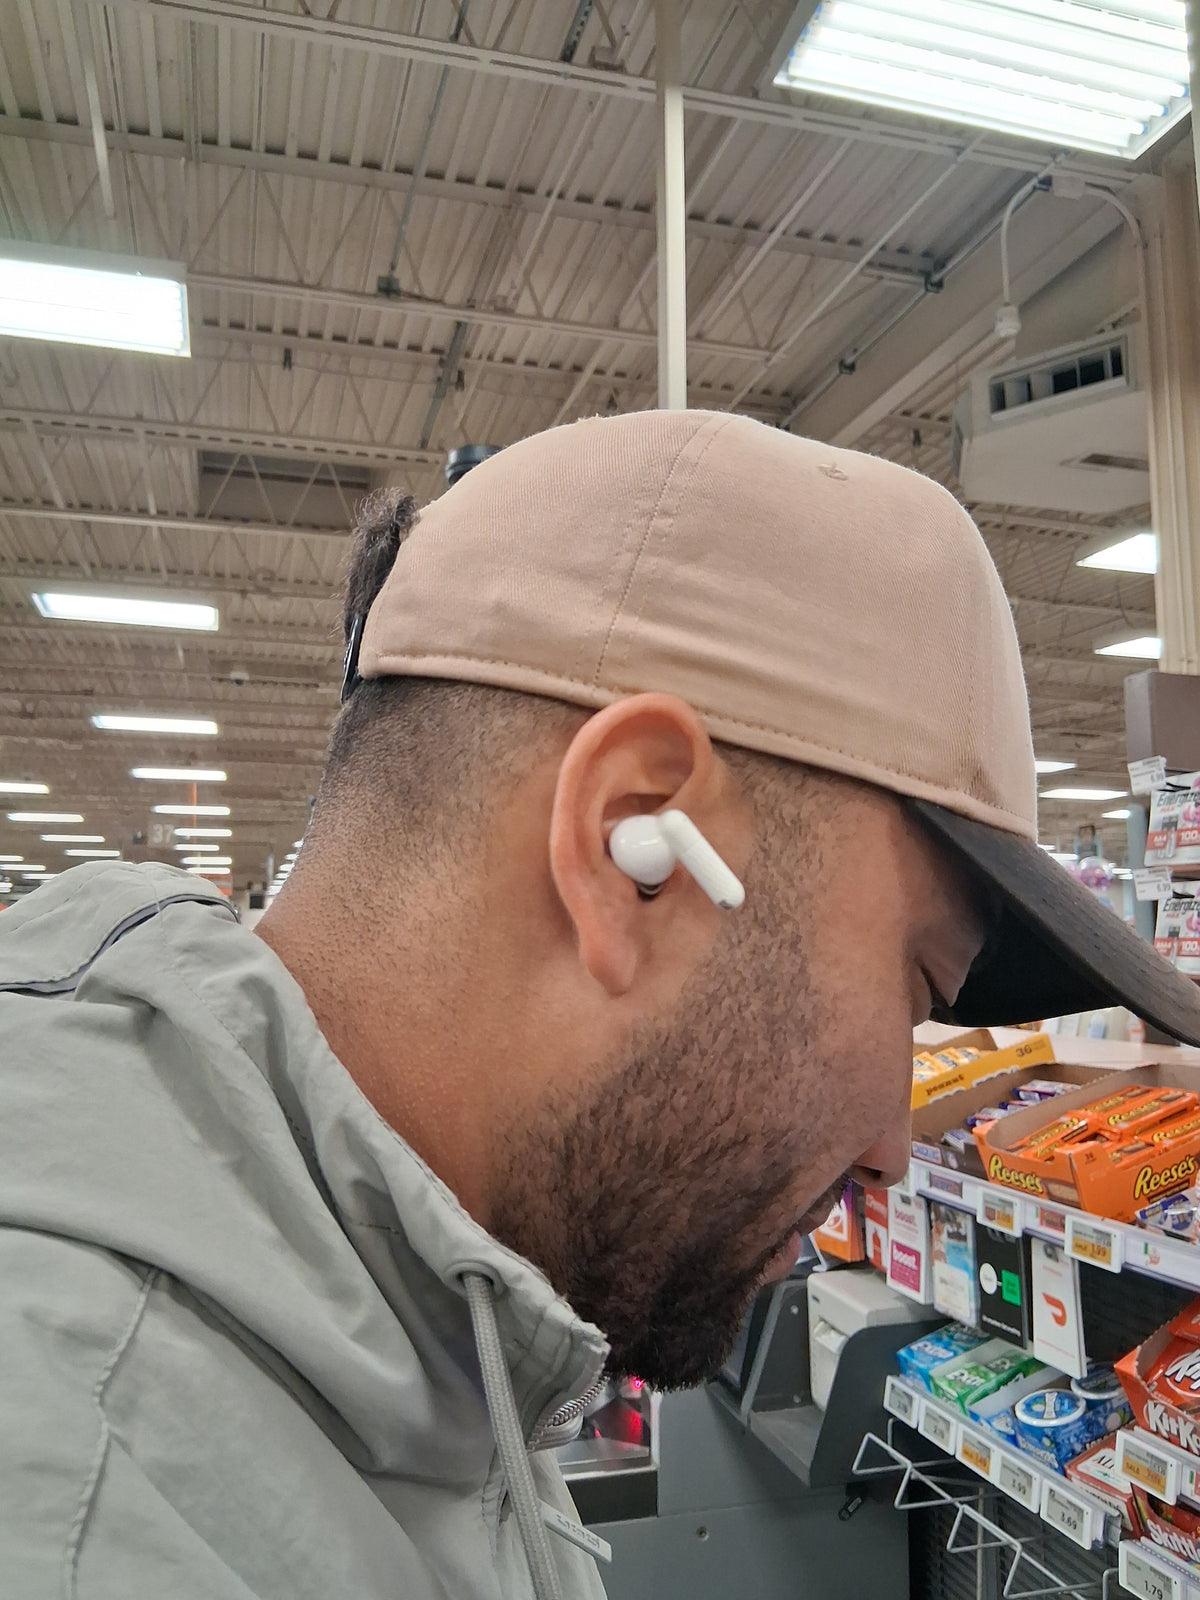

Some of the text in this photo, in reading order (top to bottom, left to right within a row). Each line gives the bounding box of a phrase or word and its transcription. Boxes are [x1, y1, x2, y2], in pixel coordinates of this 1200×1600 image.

[152, 823, 175, 844] 37
[926, 1074, 965, 1097] peanut
[989, 1154, 1044, 1193] Reese's
[1133, 1155, 1196, 1200] Reese's
[1144, 1579, 1164, 1600] 1.79
